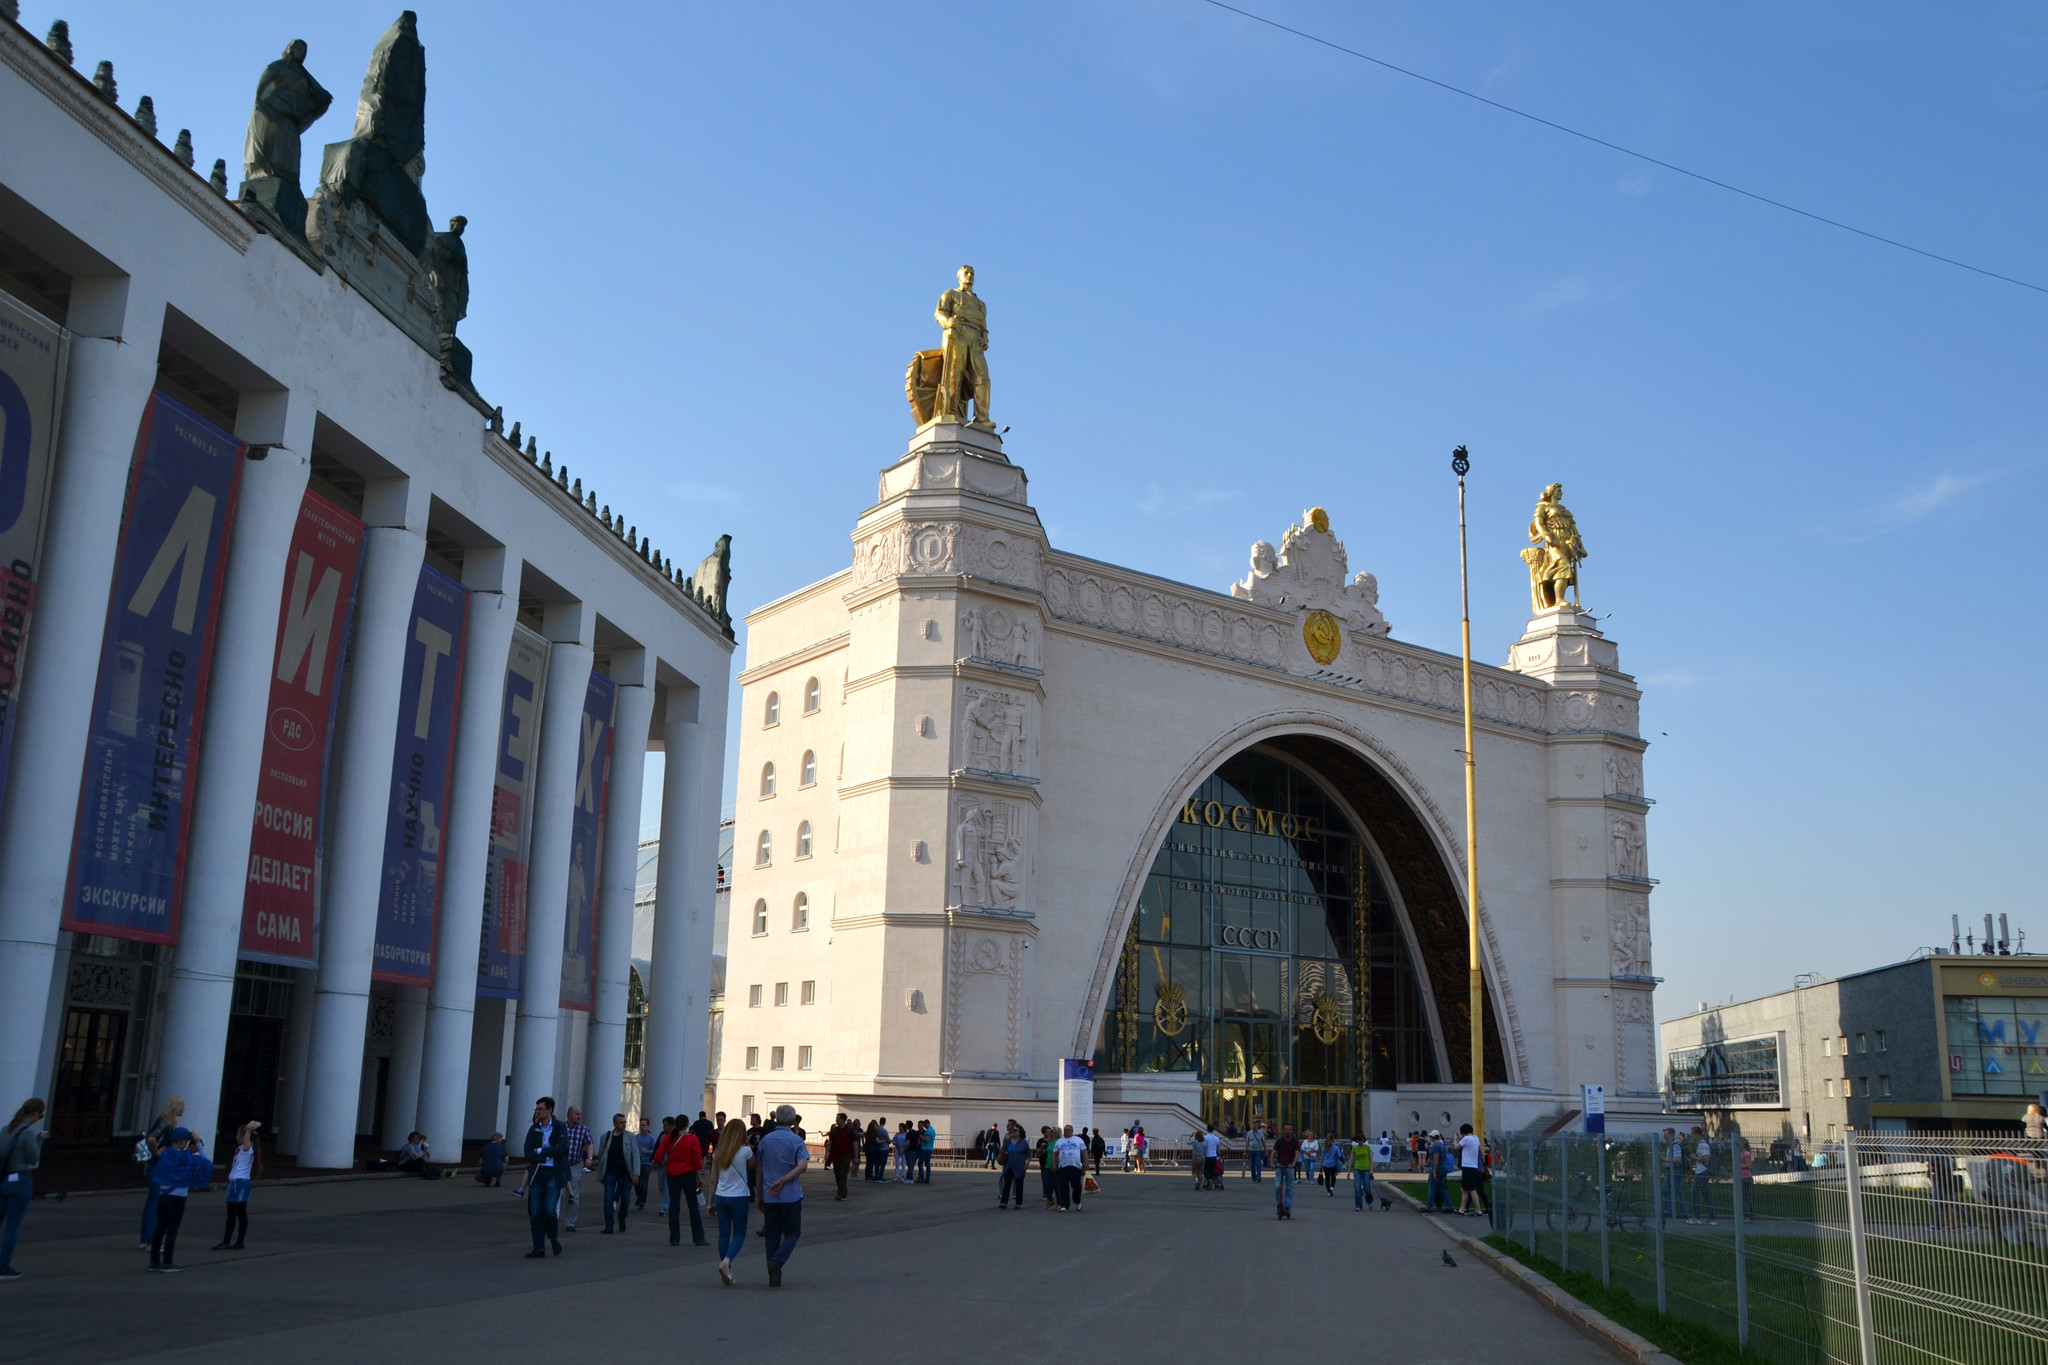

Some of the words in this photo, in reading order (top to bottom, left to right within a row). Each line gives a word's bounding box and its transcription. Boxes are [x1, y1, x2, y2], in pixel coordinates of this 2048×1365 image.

[175, 424, 218, 457] POLYMUS.RU
[127, 485, 216, 636] Л
[277, 550, 342, 696] И
[415, 616, 452, 740] Т
[147, 650, 187, 832] ИНТЕРЕСНО
[282, 718, 302, 739] РДС
[499, 669, 534, 782] Е
[269, 768, 307, 788] ЭКСПОЗИЦИЯ
[575, 711, 604, 814] Х
[95, 748, 114, 859] ИССЛЕДОВАТЕЛЕМ
[254, 799, 312, 841] РОССИЯ
[403, 752, 424, 849] НАУЧНО
[1181, 797, 1321, 843] КОСМОС
[110, 820, 122, 861] МОЖЕТ
[249, 855, 311, 893] ДЕЛАЕТ
[82, 885, 166, 916] ЭКСКУРСИИ
[256, 911, 301, 943] САМА
[1222, 926, 1280, 949] СССР
[374, 943, 431, 967] ЛАБОРАТОРИЯ
